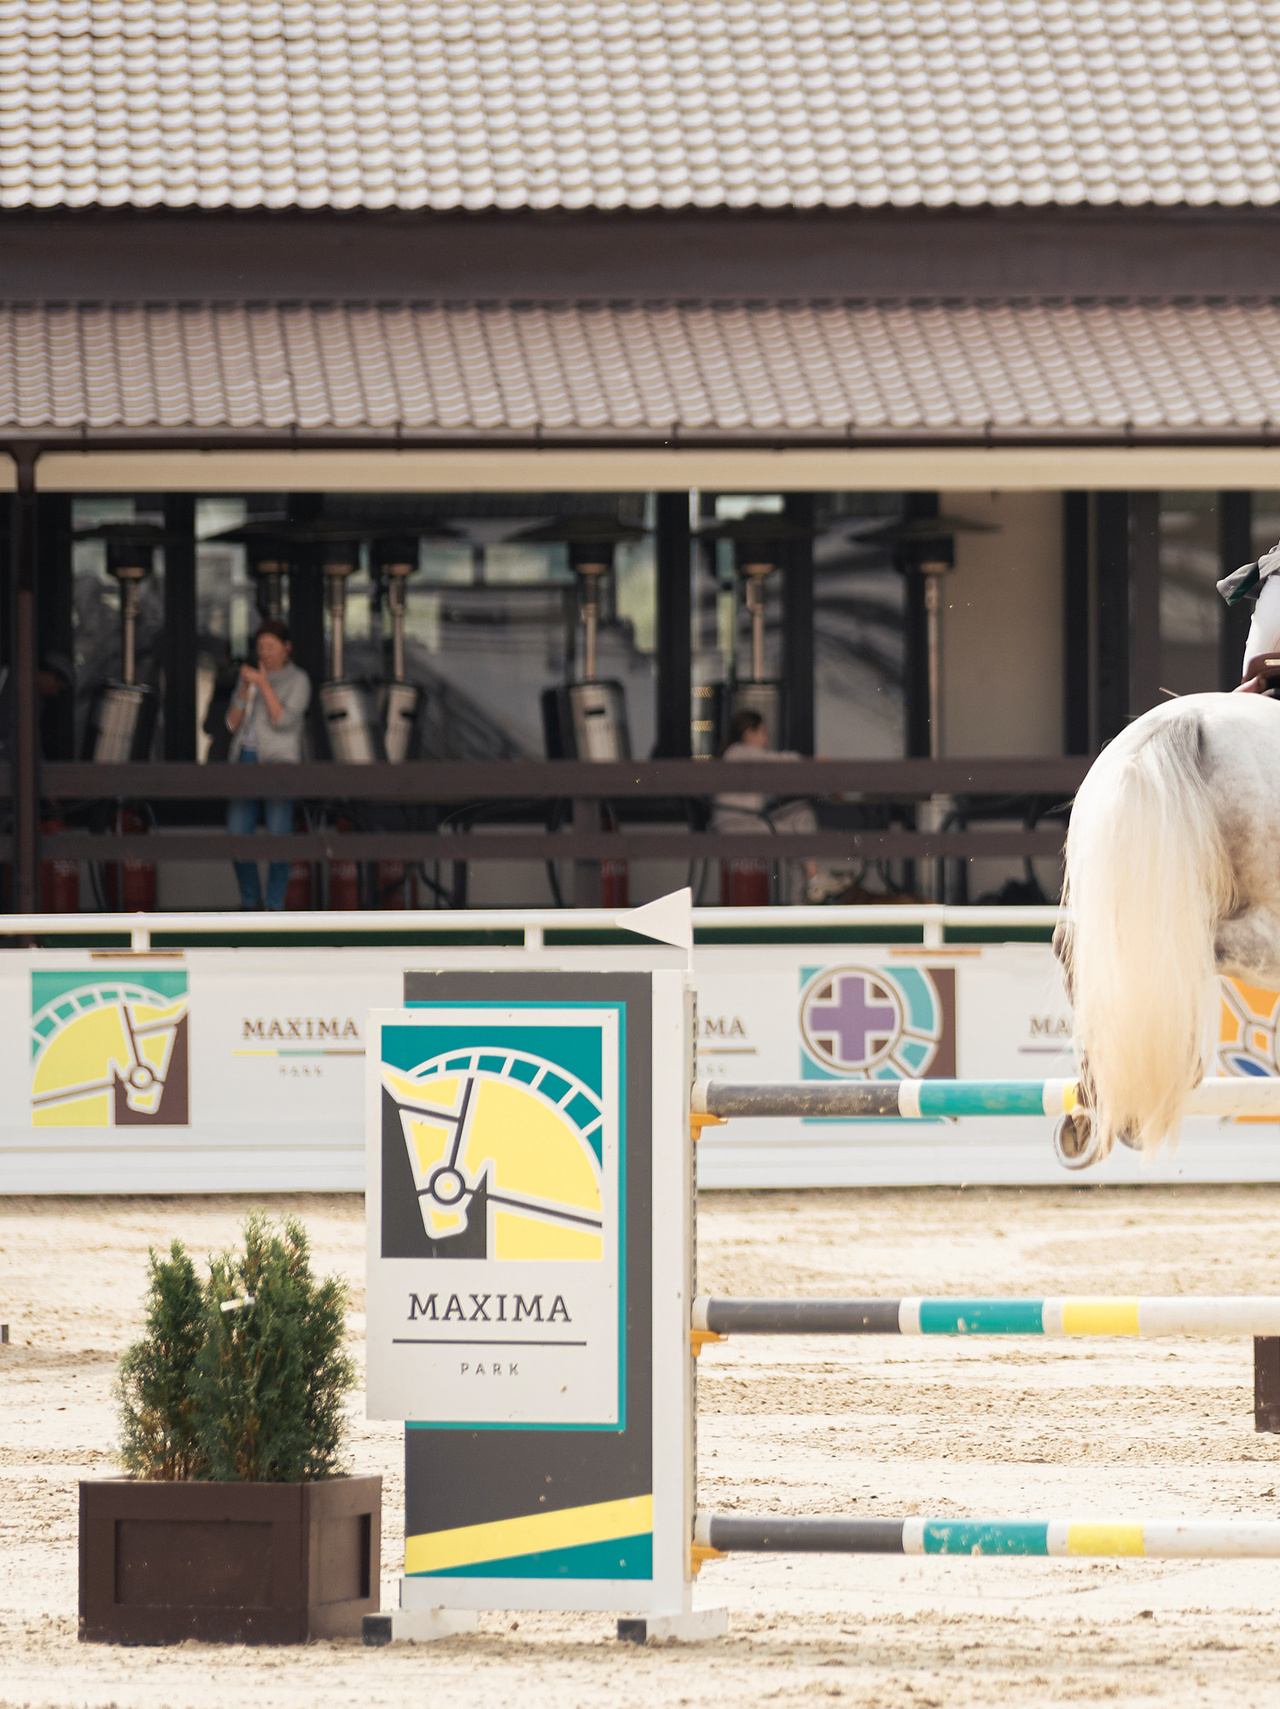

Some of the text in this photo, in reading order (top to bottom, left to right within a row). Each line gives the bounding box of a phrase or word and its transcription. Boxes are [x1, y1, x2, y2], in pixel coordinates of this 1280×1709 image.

[242, 1017, 360, 1039] MAXIMA
[407, 1293, 572, 1323] MAXIMA
[460, 1362, 520, 1376] PARK
